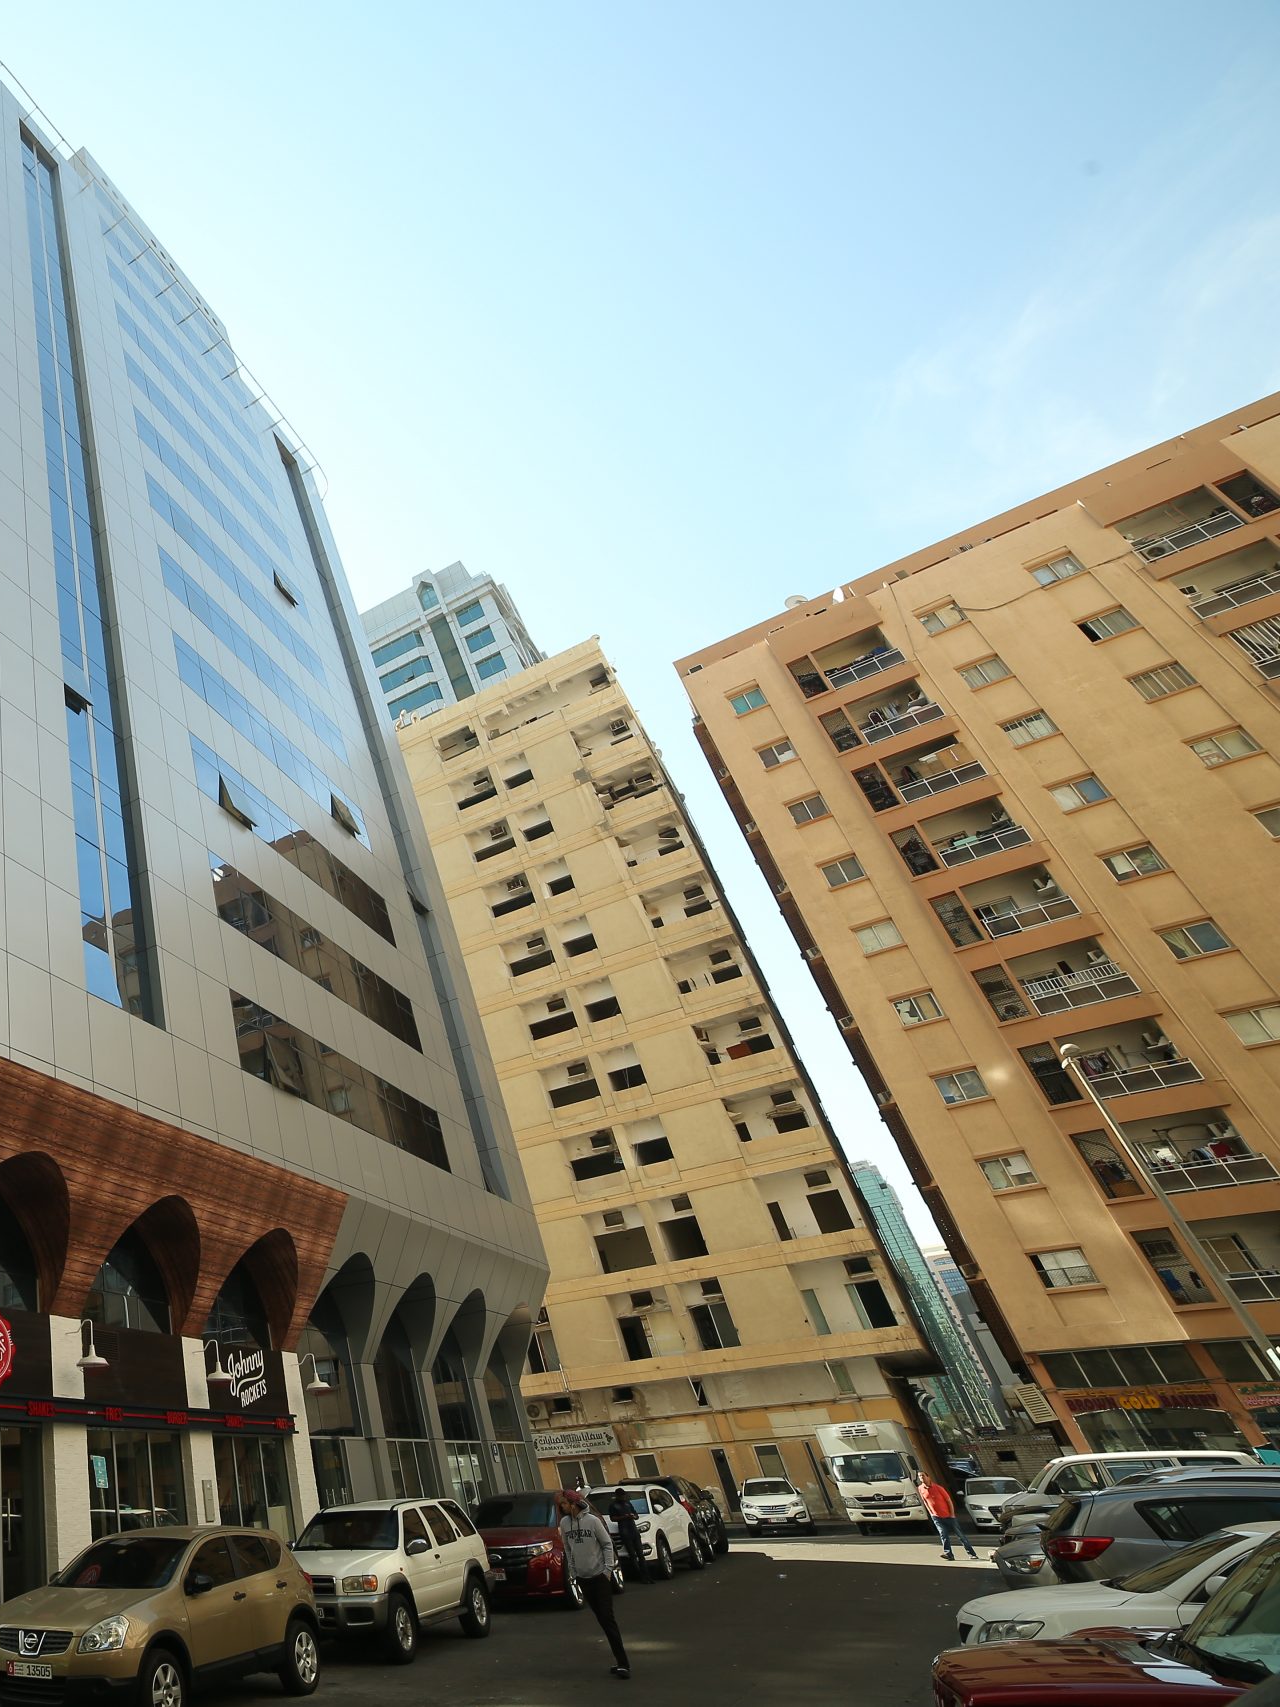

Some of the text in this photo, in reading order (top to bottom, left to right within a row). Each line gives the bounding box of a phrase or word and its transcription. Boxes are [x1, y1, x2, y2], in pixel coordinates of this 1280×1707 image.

[227, 1349, 264, 1398] Johnny
[240, 1379, 267, 1408] ROCKETS
[27, 1400, 56, 1417] SHAKES
[1066, 1397, 1118, 1411] BROWN
[1119, 1395, 1162, 1409] GOLD
[26, 1664, 51, 1677] 13505
